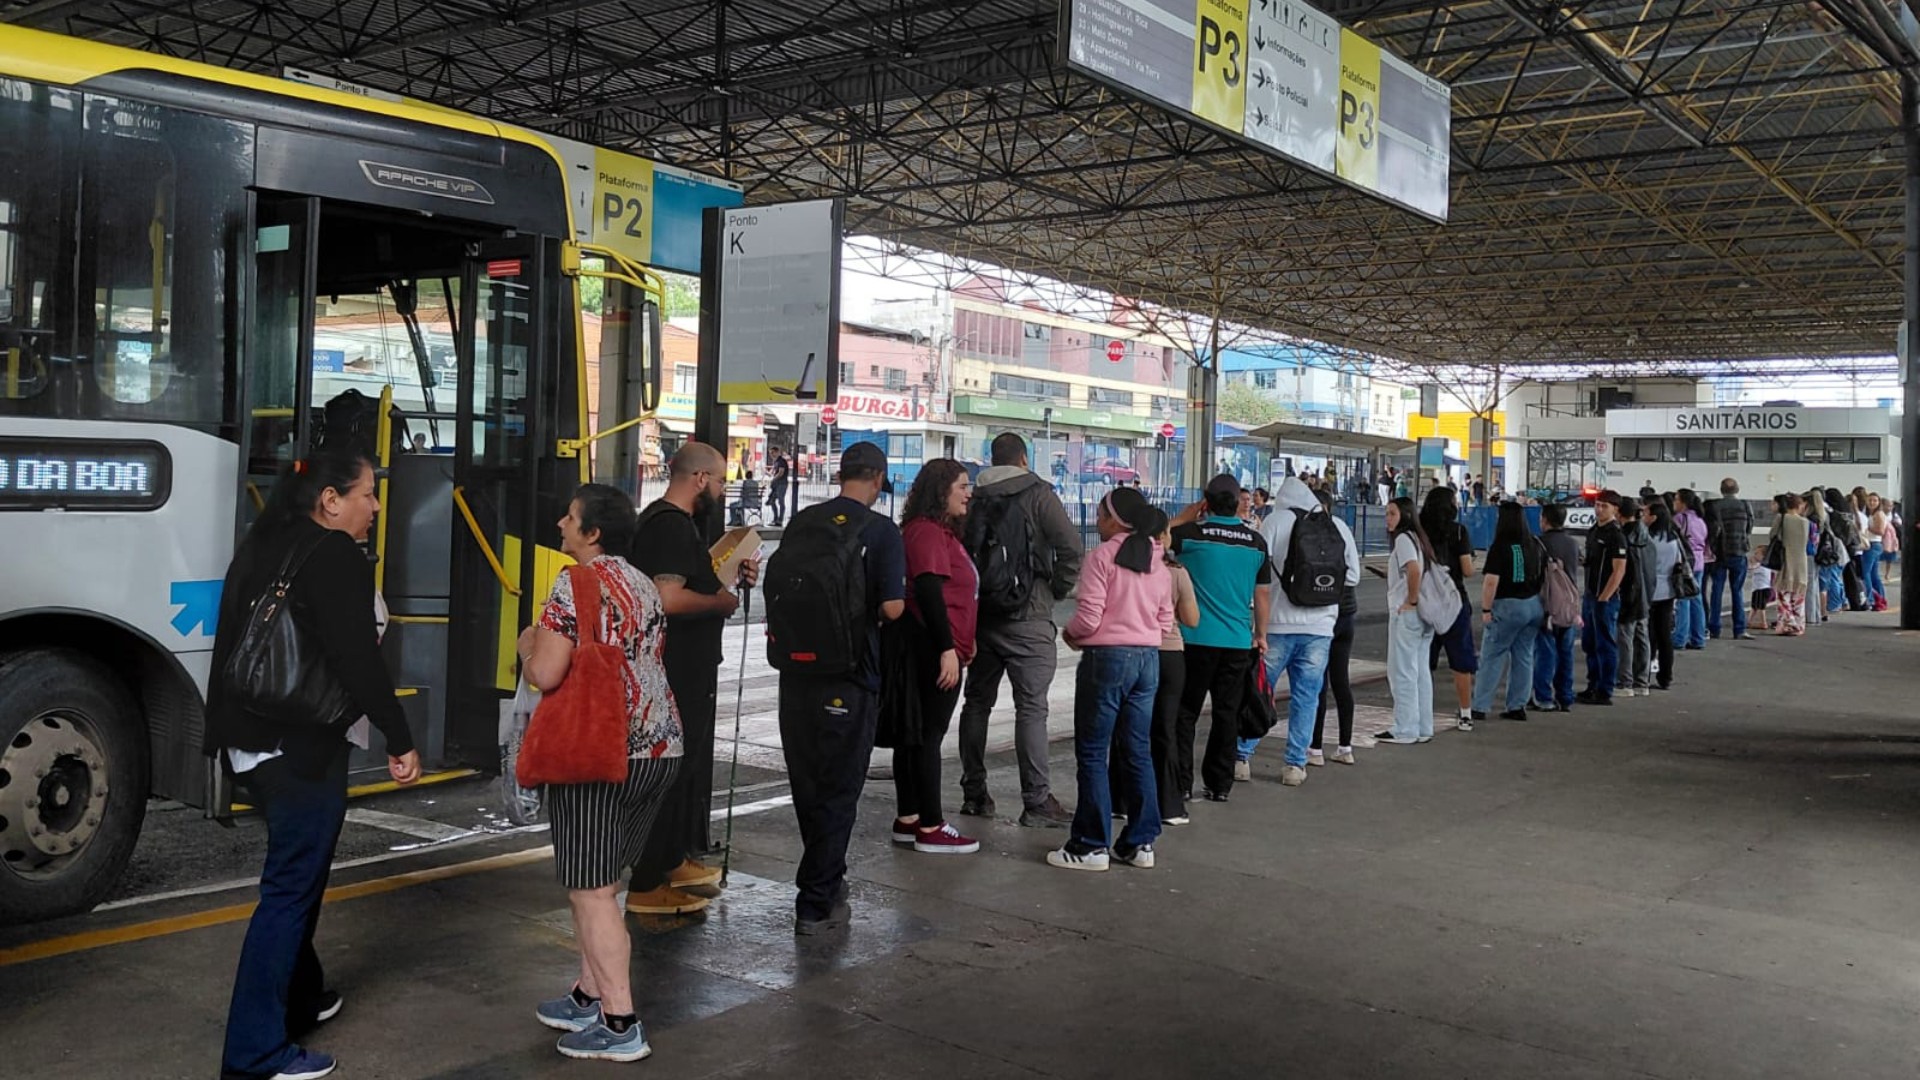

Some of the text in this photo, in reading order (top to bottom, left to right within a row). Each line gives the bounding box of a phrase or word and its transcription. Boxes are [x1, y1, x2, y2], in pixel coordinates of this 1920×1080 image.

[1198, 14, 1241, 88] P3
[1267, 36, 1307, 69] Informações
[335, 80, 369, 96] Ponto E
[1341, 65, 1376, 93] Plataforma
[1286, 86, 1309, 108] Policial
[1340, 88, 1374, 150] P3
[377, 169, 476, 194] APACHE VIP
[599, 172, 649, 193] Plataforma
[603, 192, 643, 238] P2
[729, 214, 758, 227] Ponto
[730, 231, 745, 255] K
[838, 395, 925, 418] BURGÃO
[1676, 408, 1798, 431] SANITÁRIOS
[16, 458, 68, 490] DA
[75, 460, 147, 491] BOA
[1202, 527, 1253, 542] PETRONAS
